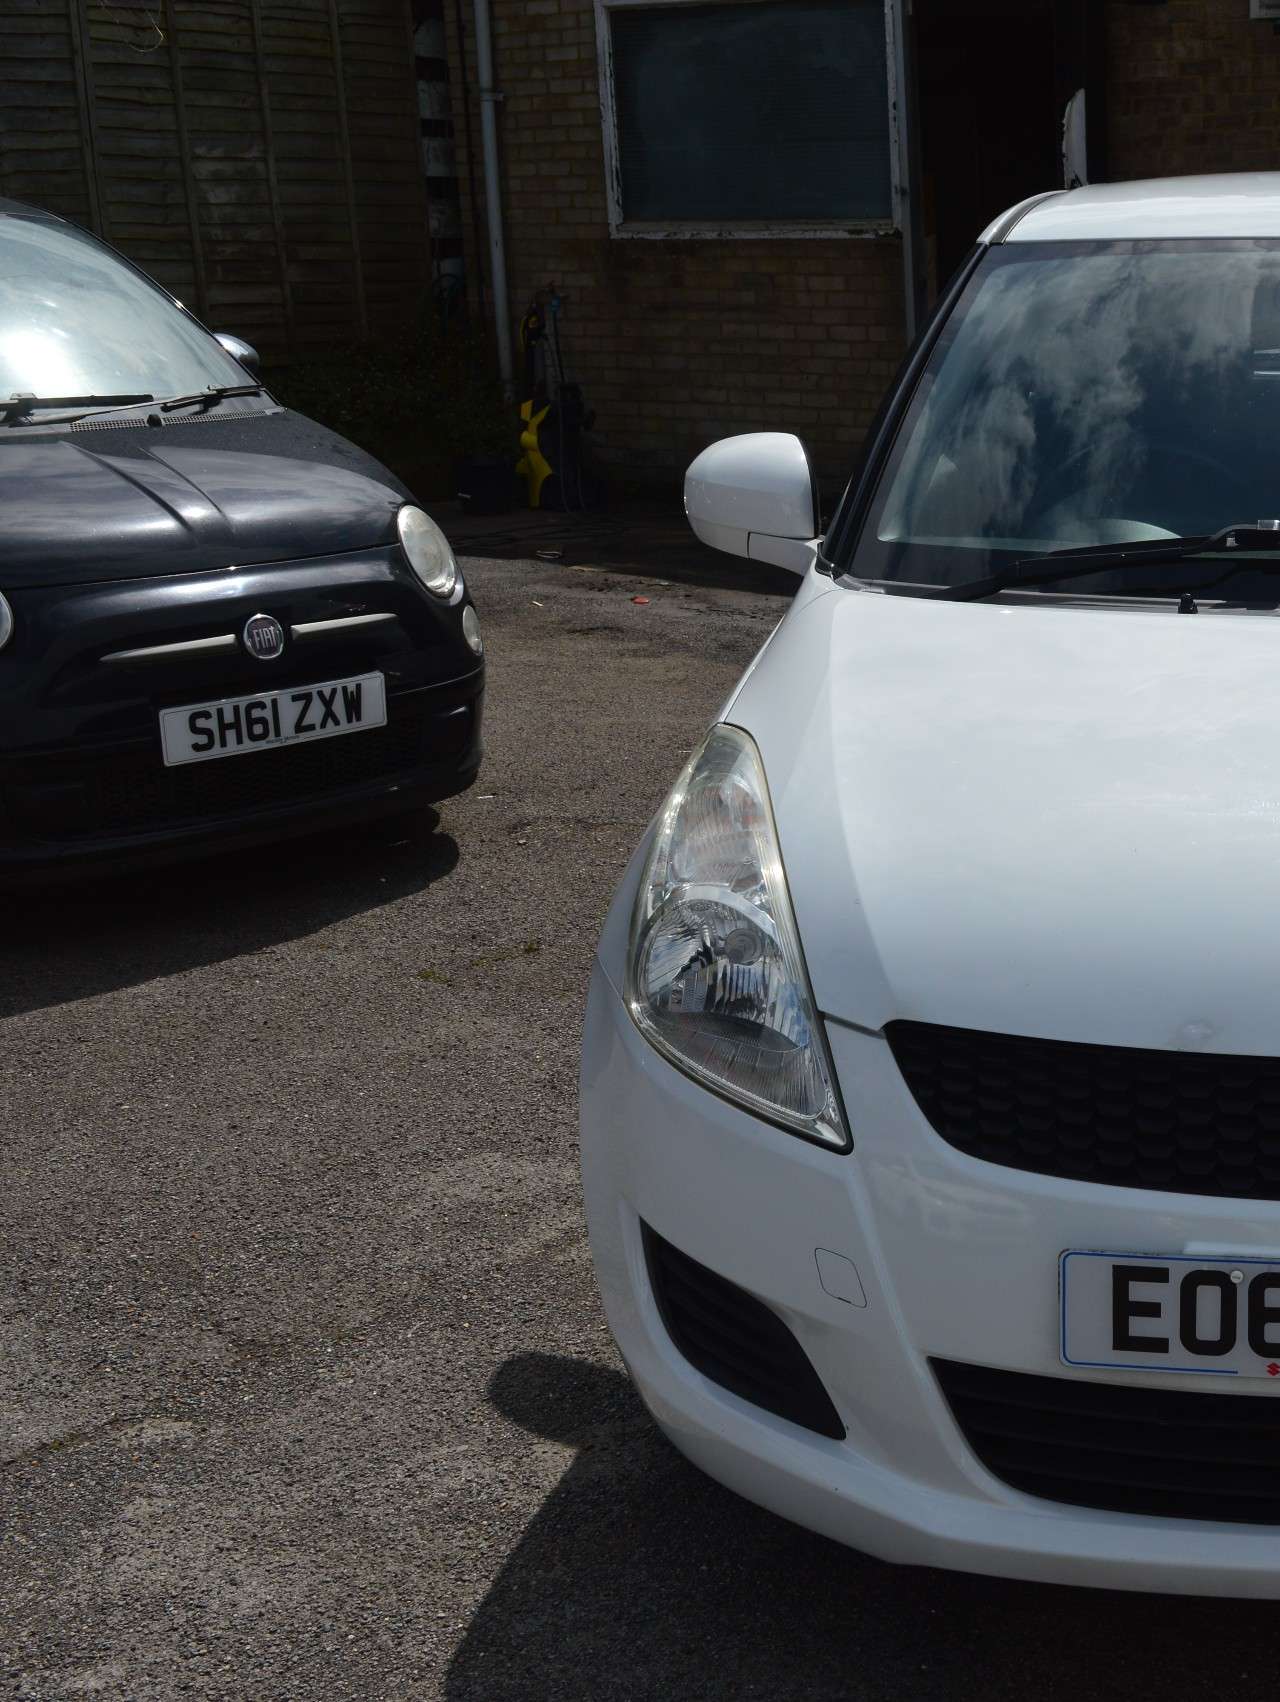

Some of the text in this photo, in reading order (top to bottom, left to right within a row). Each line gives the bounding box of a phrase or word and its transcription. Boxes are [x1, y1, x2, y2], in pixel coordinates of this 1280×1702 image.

[252, 625, 277, 649] FIAT
[188, 683, 363, 753] SH61 ZXW
